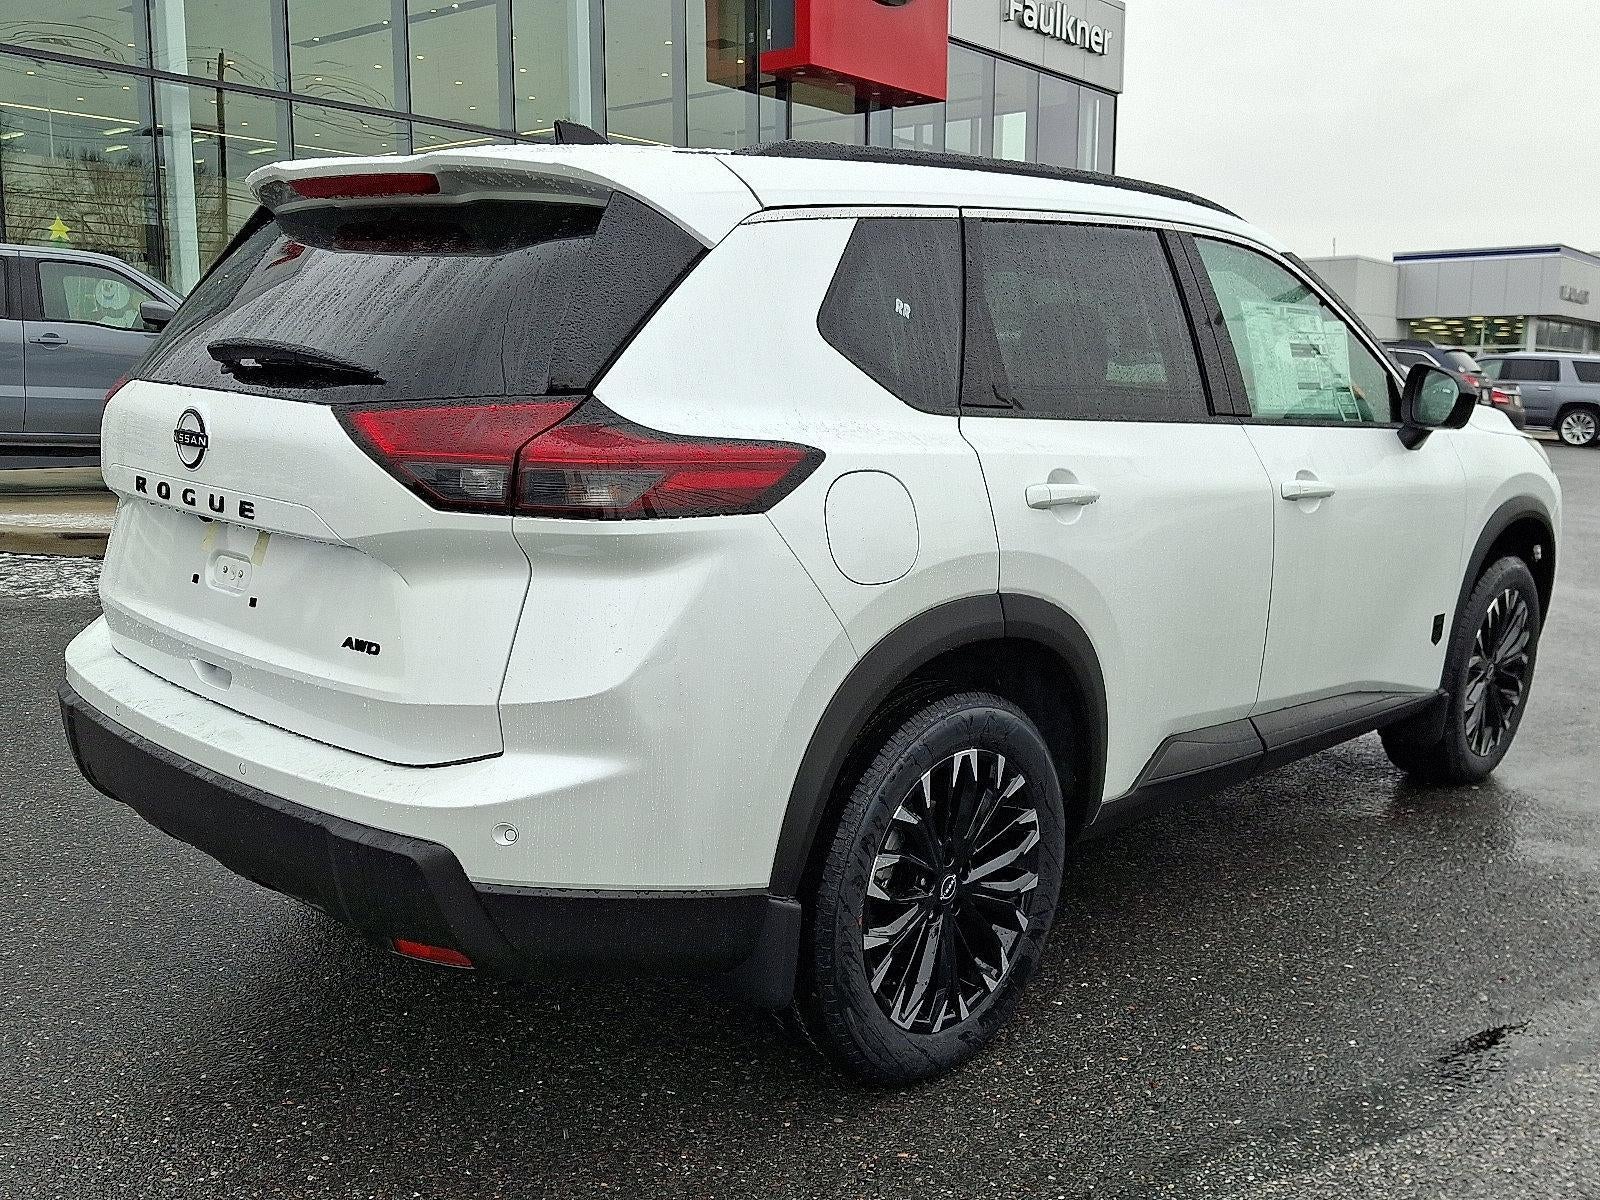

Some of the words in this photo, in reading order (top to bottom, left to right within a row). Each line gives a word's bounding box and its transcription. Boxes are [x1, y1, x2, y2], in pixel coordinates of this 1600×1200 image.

[1007, 0, 1112, 55] Faulkner
[174, 431, 207, 446] SSAN
[135, 475, 256, 520] ROGUE
[341, 636, 381, 656] AWD
